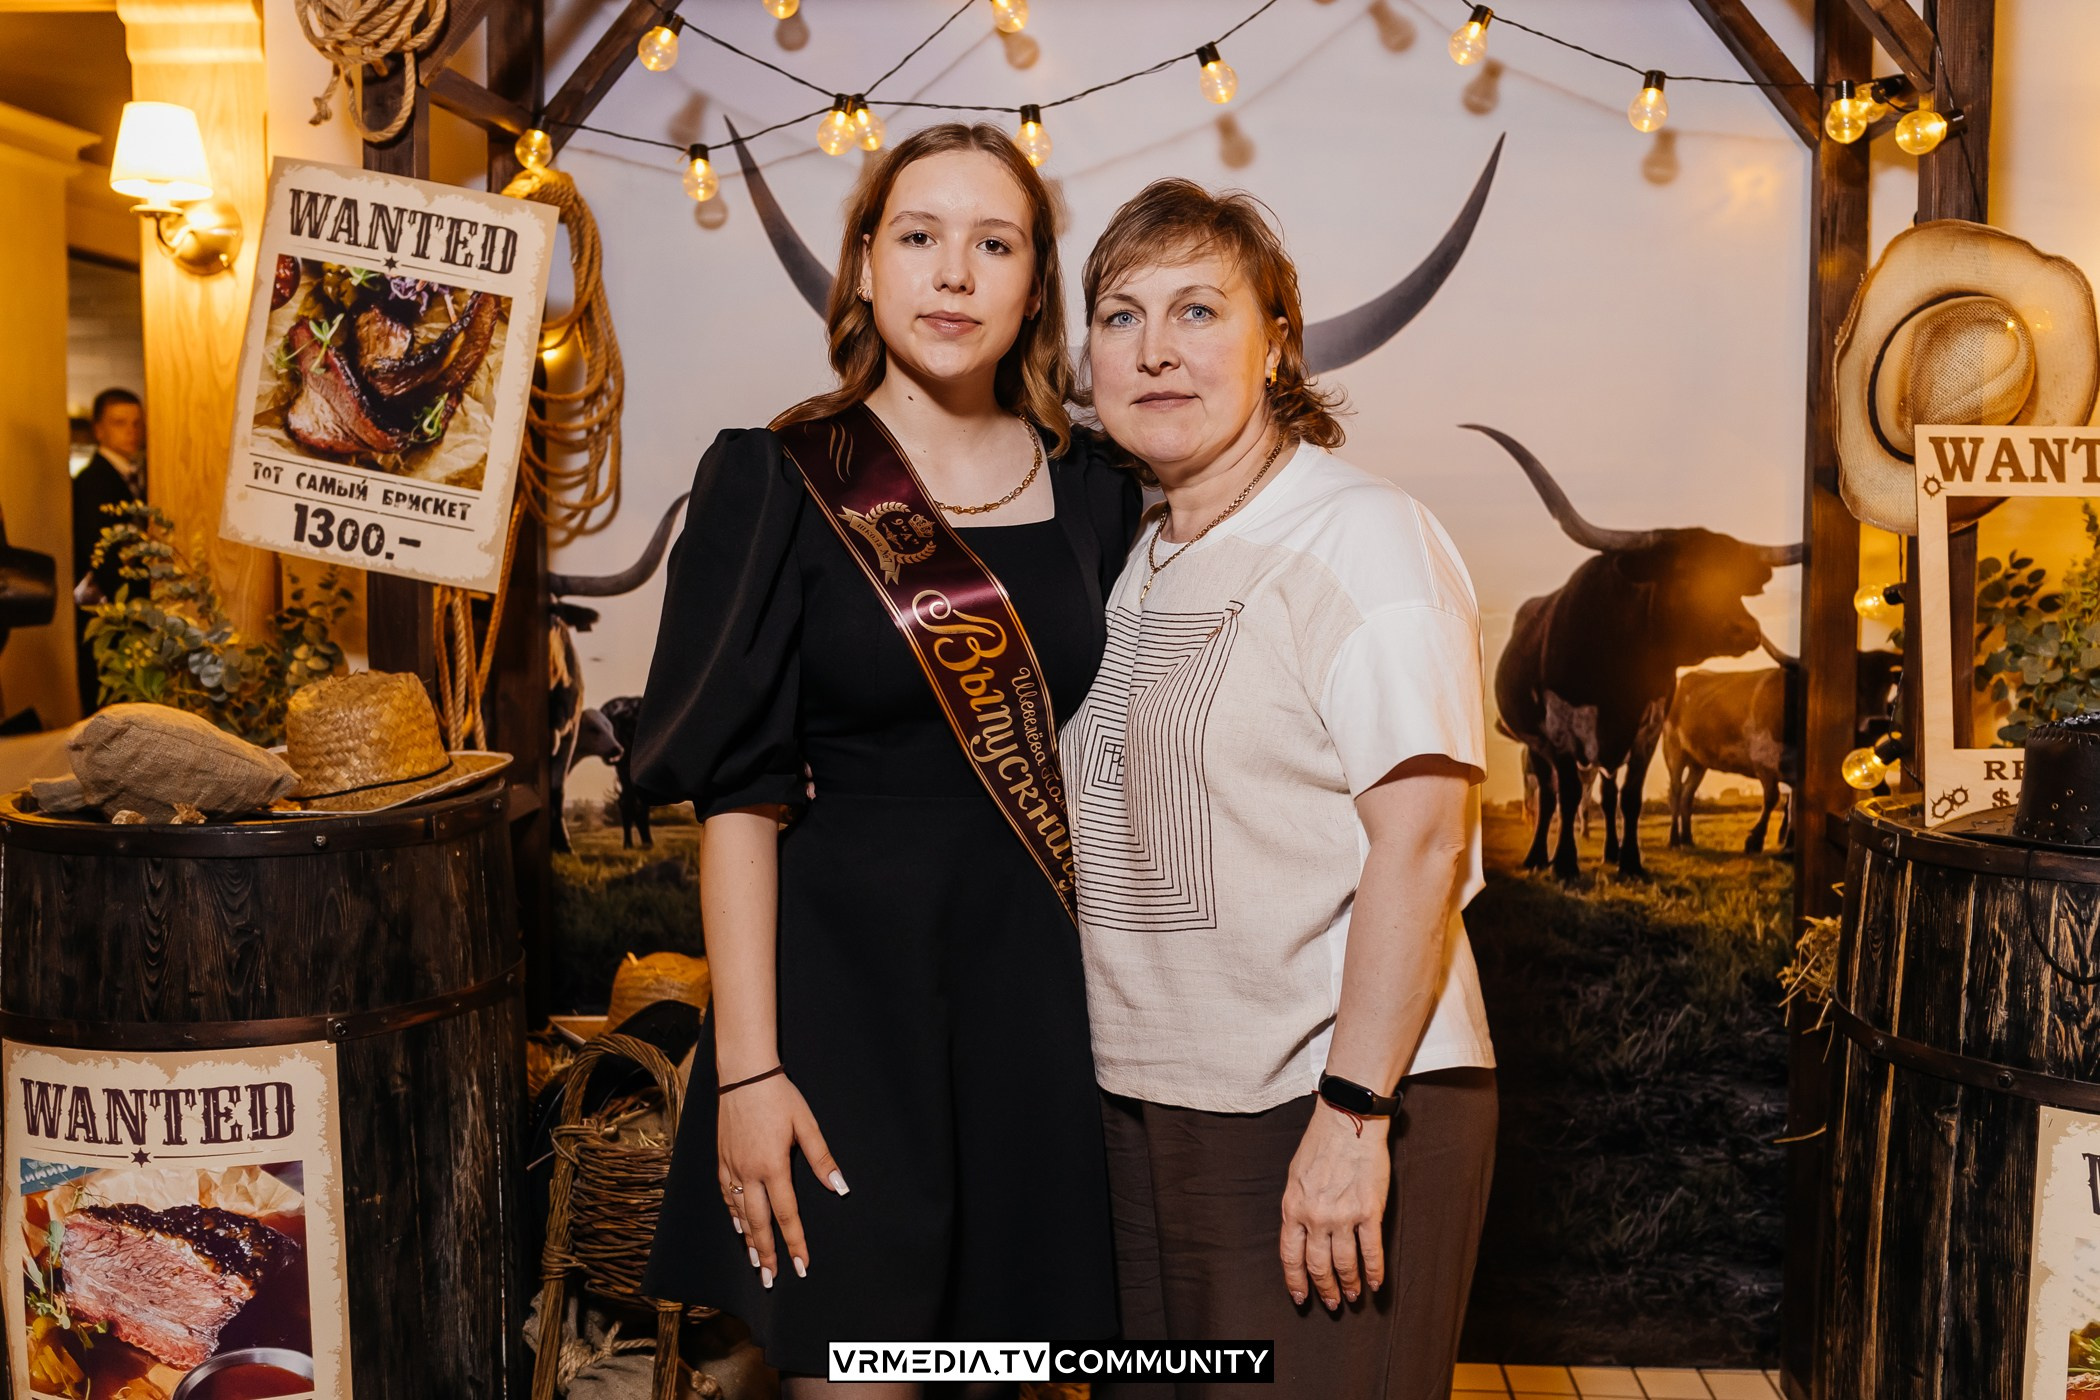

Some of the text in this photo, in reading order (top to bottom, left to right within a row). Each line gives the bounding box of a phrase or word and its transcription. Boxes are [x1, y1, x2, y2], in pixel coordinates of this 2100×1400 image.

[289, 188, 518, 275] WANTED
[1929, 436, 2100, 483] WANT
[296, 472, 369, 502] САМЫЙ
[382, 488, 472, 521] БРИСКЕТ
[1011, 667, 1047, 767] Шевелёва
[20, 1078, 296, 1146] WANTED
